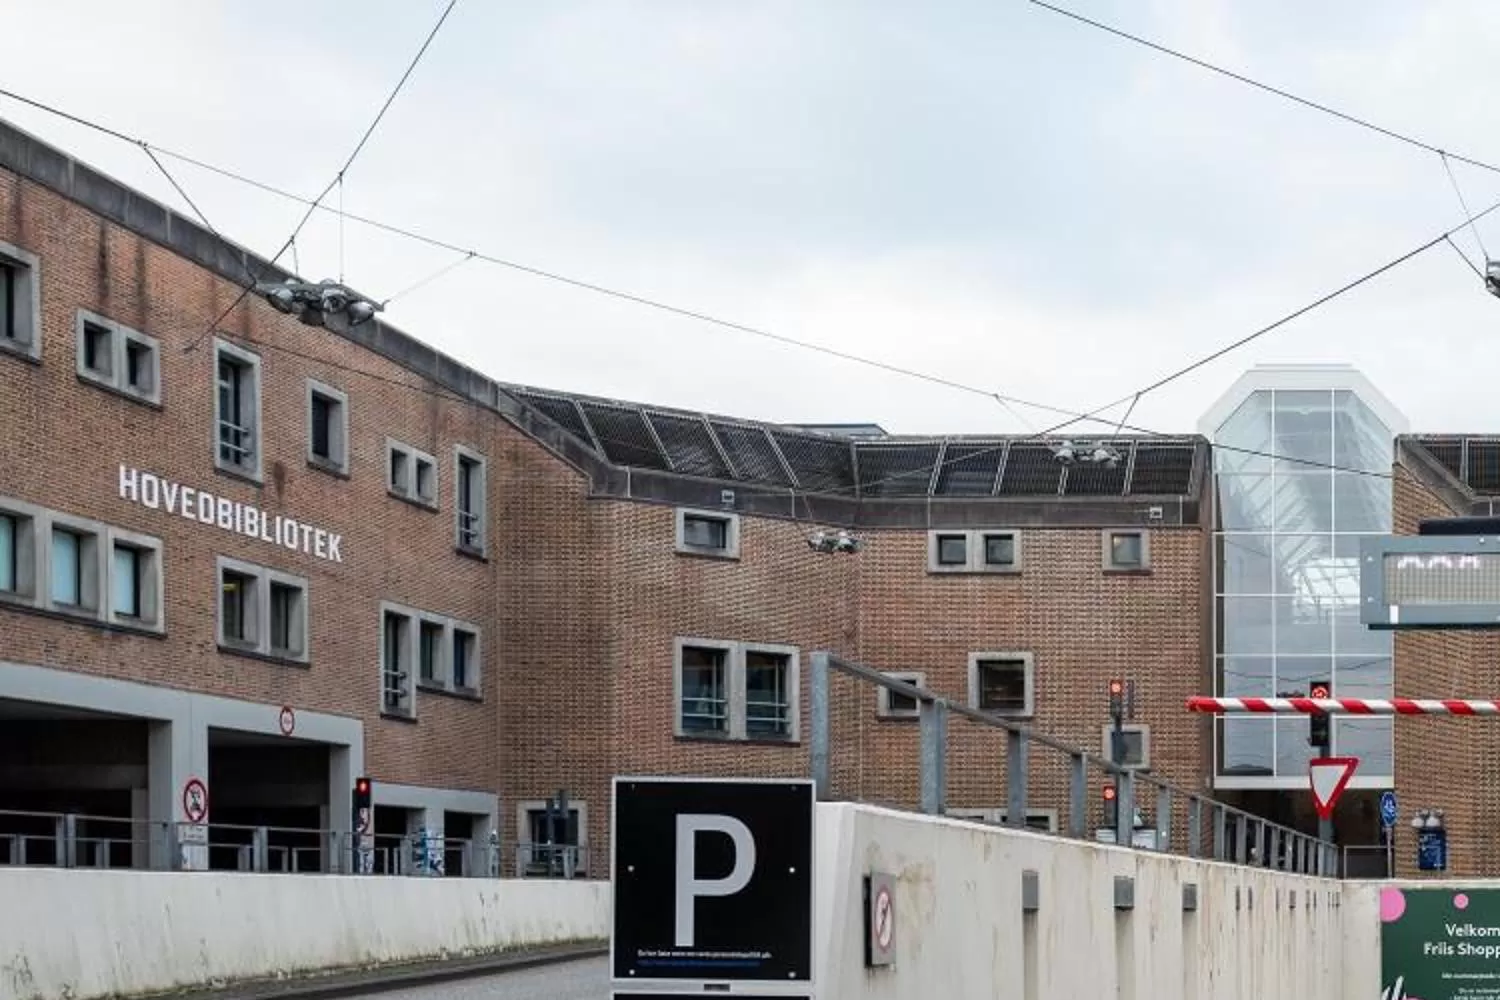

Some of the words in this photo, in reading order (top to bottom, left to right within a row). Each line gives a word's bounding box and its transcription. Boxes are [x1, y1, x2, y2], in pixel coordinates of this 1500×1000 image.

[119, 464, 342, 562] HOVEDBIBLIOTEK
[675, 813, 756, 947] P
[1423, 942, 1455, 955] Friis
